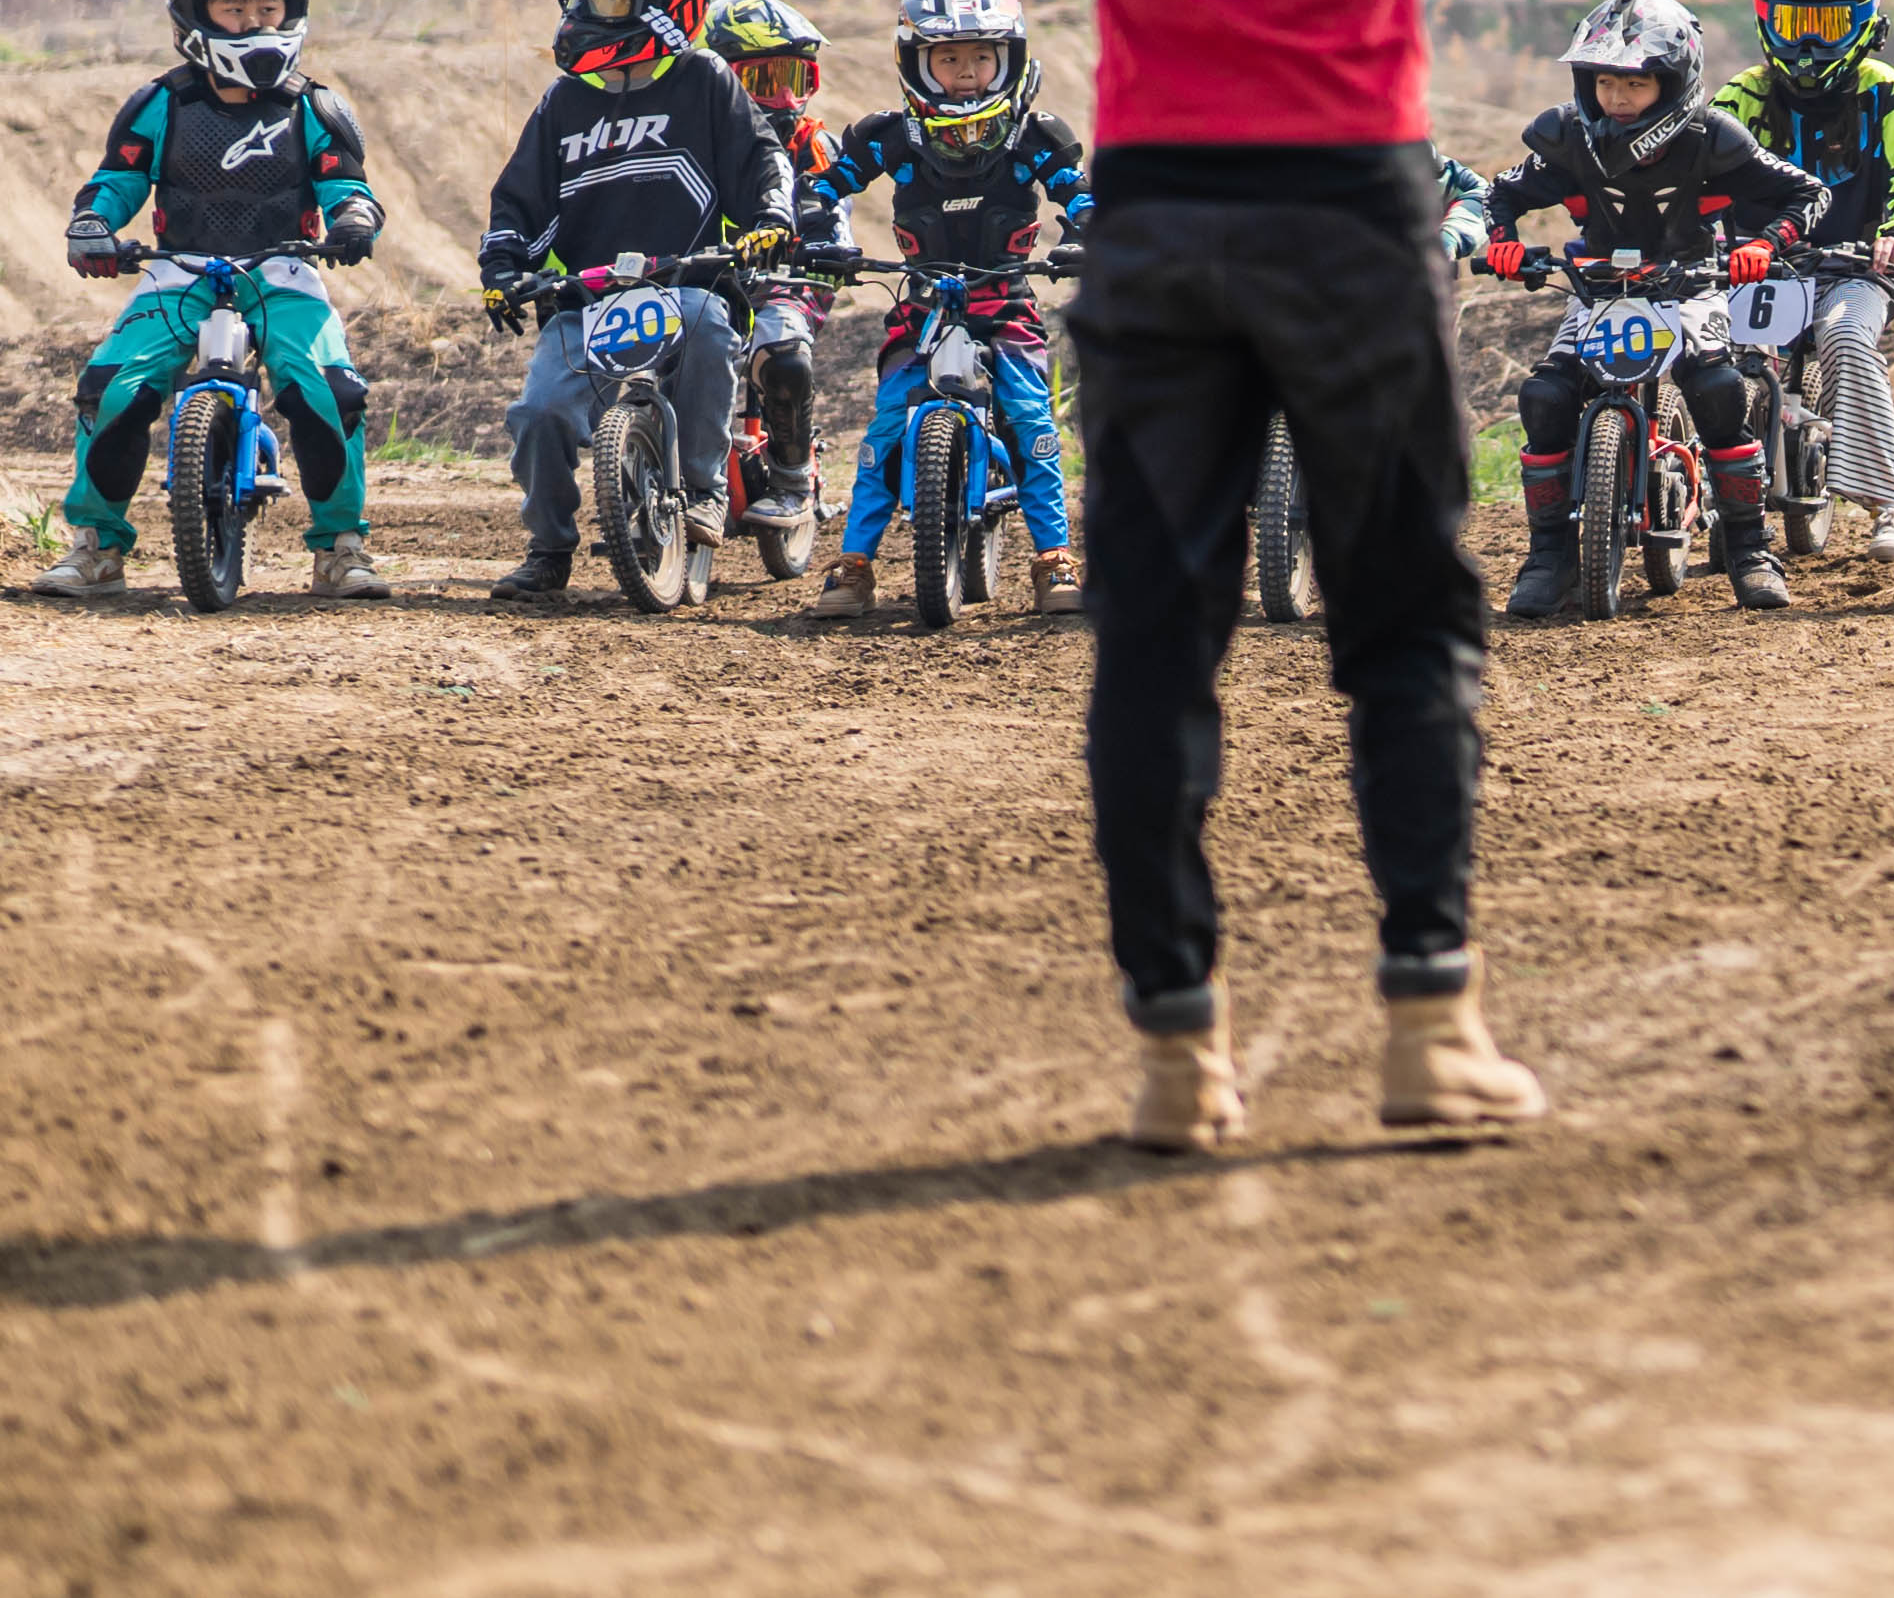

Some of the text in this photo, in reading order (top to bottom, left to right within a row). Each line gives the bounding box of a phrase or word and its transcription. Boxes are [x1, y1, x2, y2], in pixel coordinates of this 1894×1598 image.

[941, 195, 984, 212] LEATT
[605, 299, 666, 355] 20
[1747, 284, 1777, 331] 6
[1595, 315, 1654, 365] 10
